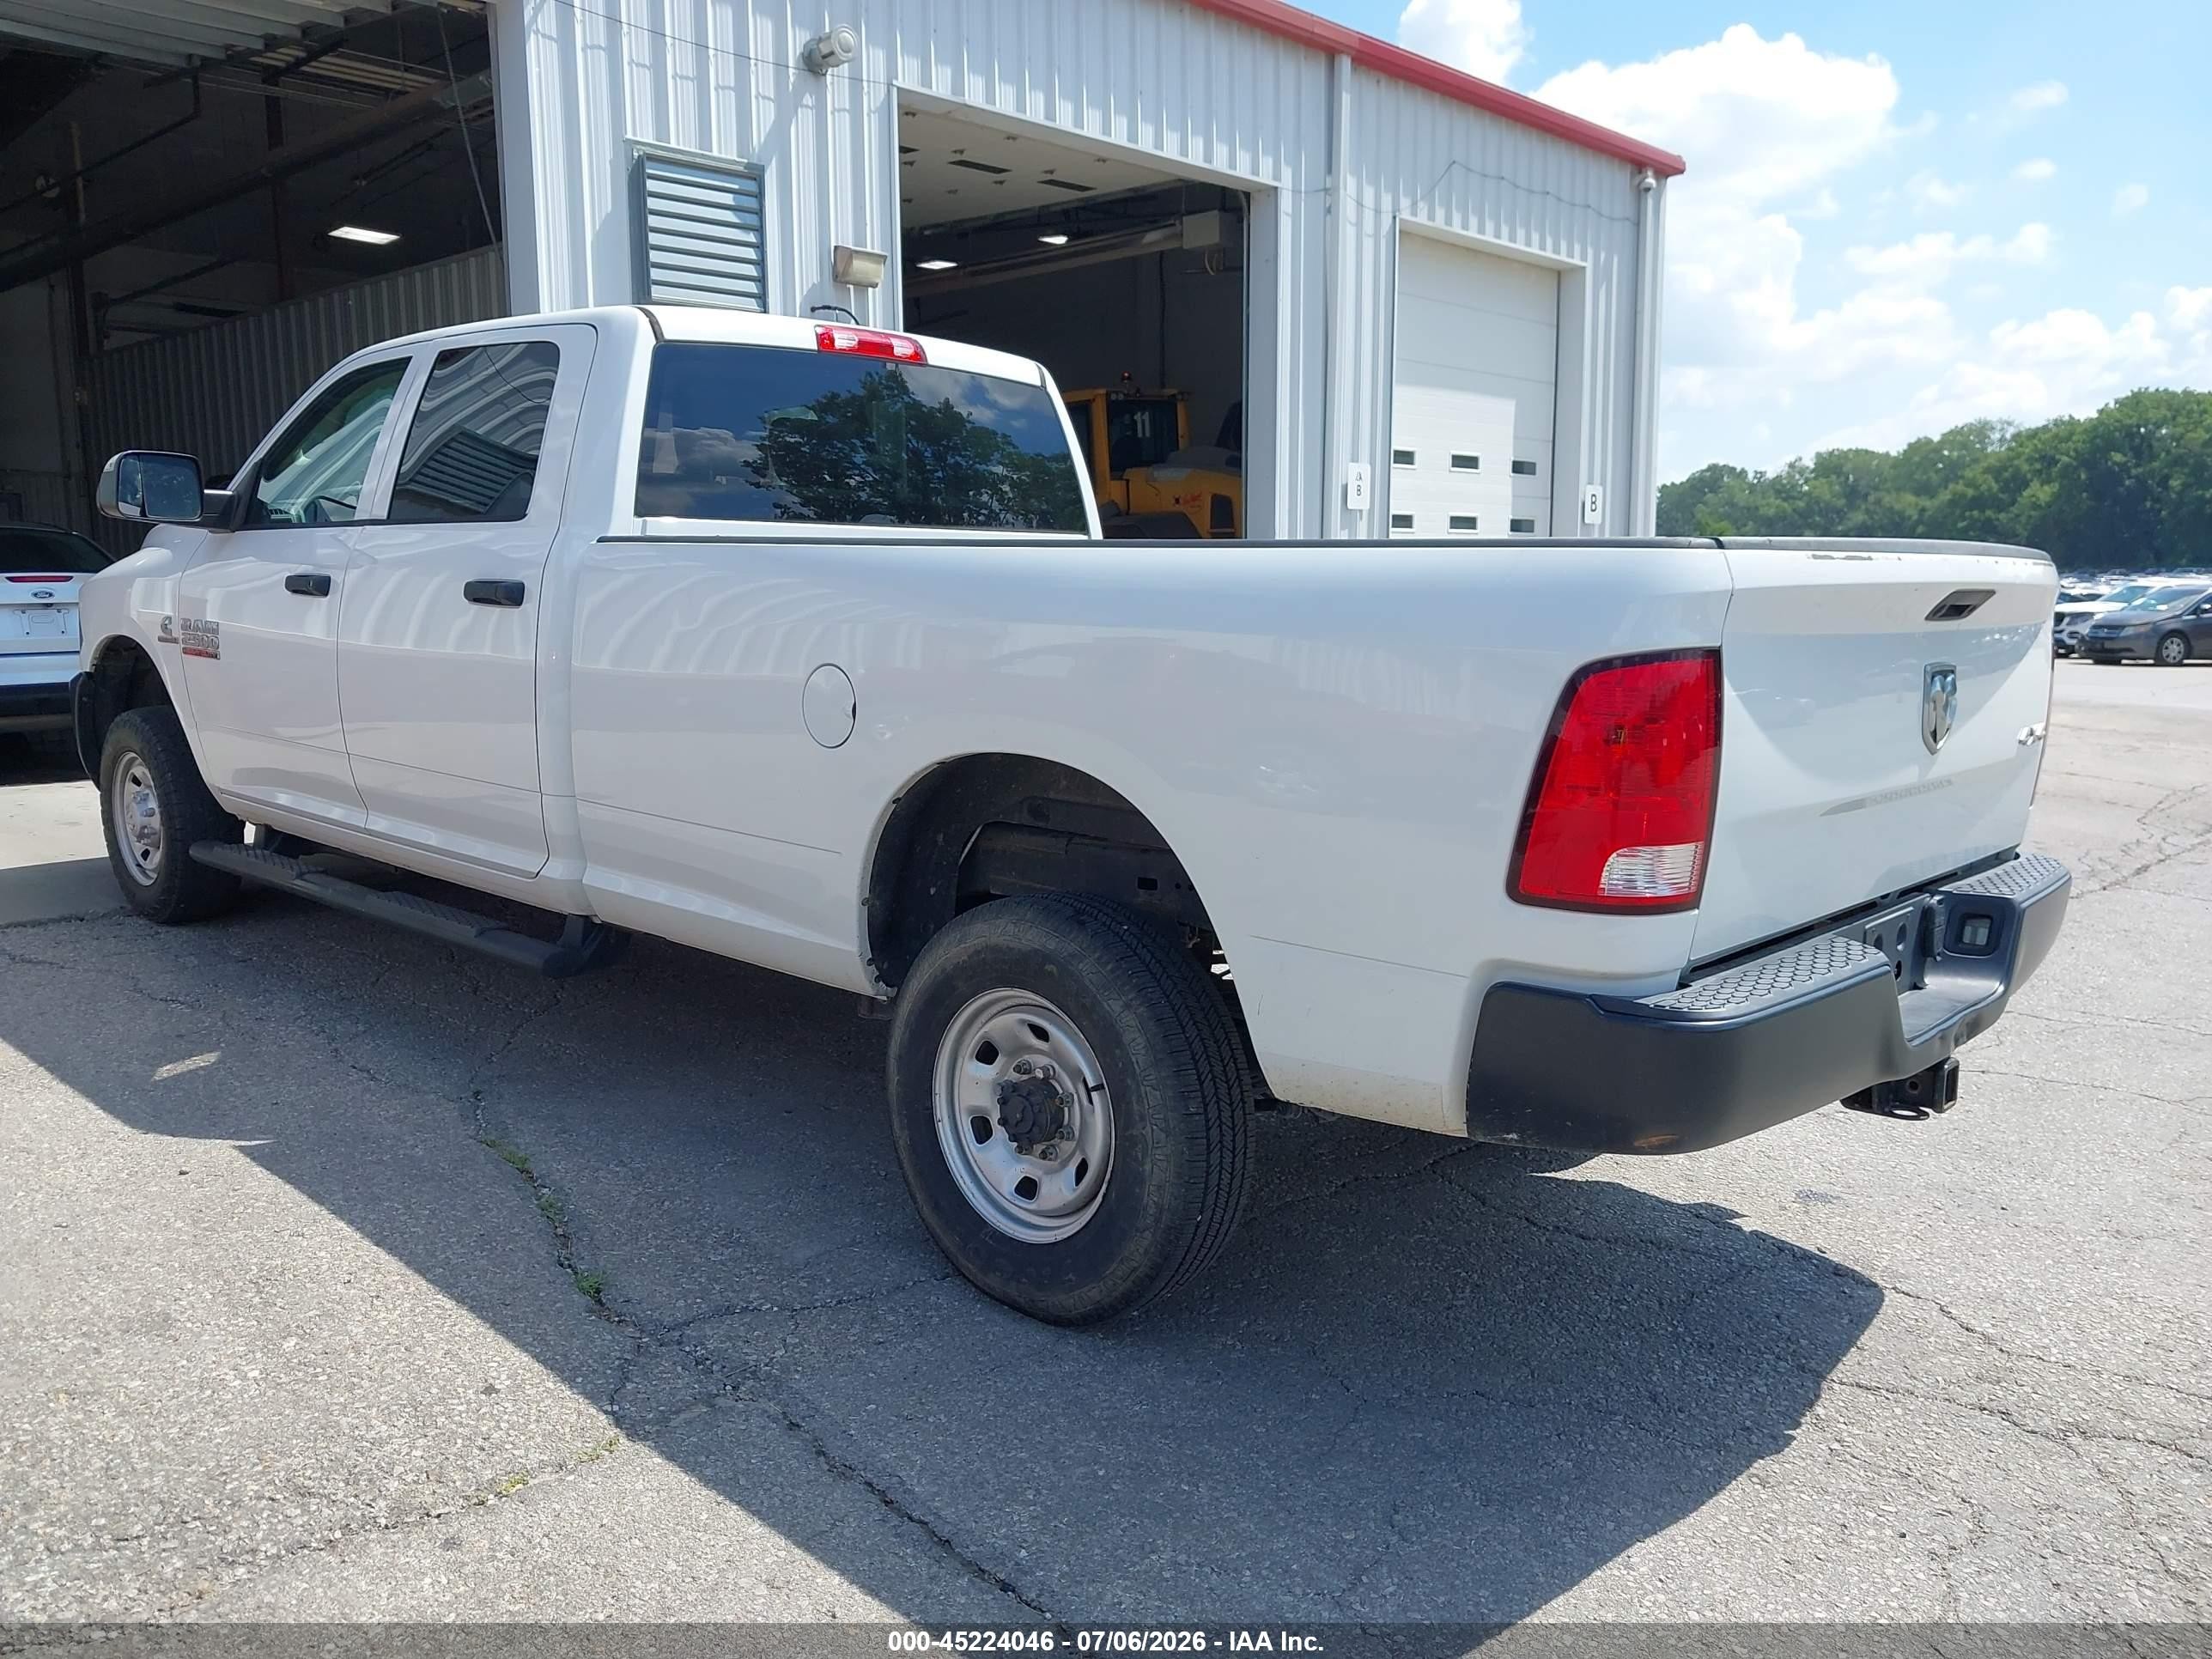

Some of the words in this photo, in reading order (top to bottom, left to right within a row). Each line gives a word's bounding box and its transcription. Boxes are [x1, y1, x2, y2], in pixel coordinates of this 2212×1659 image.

[1133, 411, 1150, 438] 11
[1356, 484, 1362, 496] B
[1590, 493, 1597, 513] B
[180, 617, 220, 635] RAM
[181, 632, 220, 650] 2500
